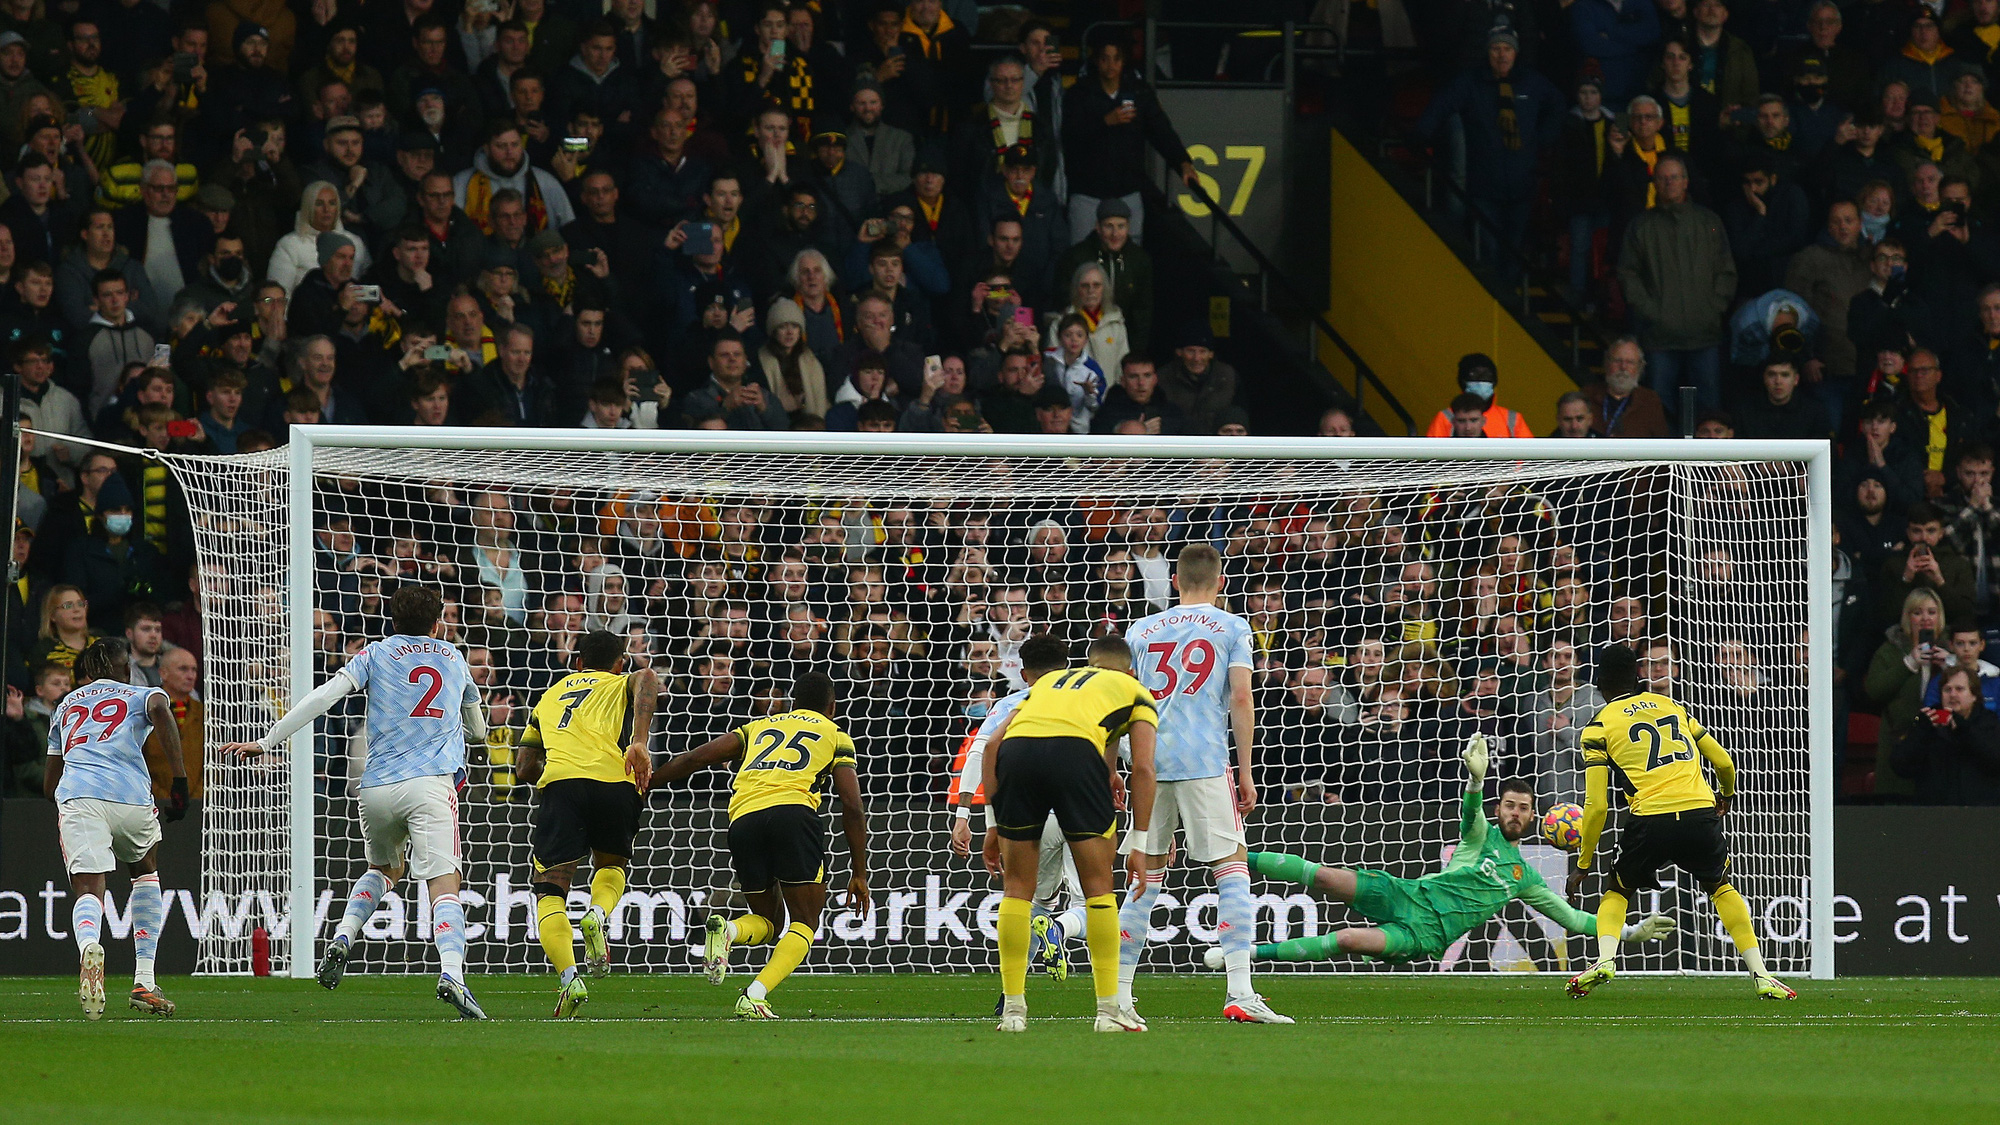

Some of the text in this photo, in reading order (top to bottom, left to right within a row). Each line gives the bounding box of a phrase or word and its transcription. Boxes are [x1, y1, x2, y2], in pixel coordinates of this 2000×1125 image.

[1178, 144, 1266, 217] S7
[1141, 614, 1225, 640] McTOMINAY
[408, 665, 444, 719] 2
[1053, 671, 1099, 689] 11
[1148, 639, 1215, 700] 39
[61, 698, 128, 757] 29
[557, 688, 594, 729] 7
[769, 714, 822, 724] DENNIS
[1623, 701, 1658, 717] SARR
[743, 728, 822, 772] 25
[1628, 714, 1694, 772] 23
[0, 880, 68, 940] at
[1894, 885, 1970, 944] at
